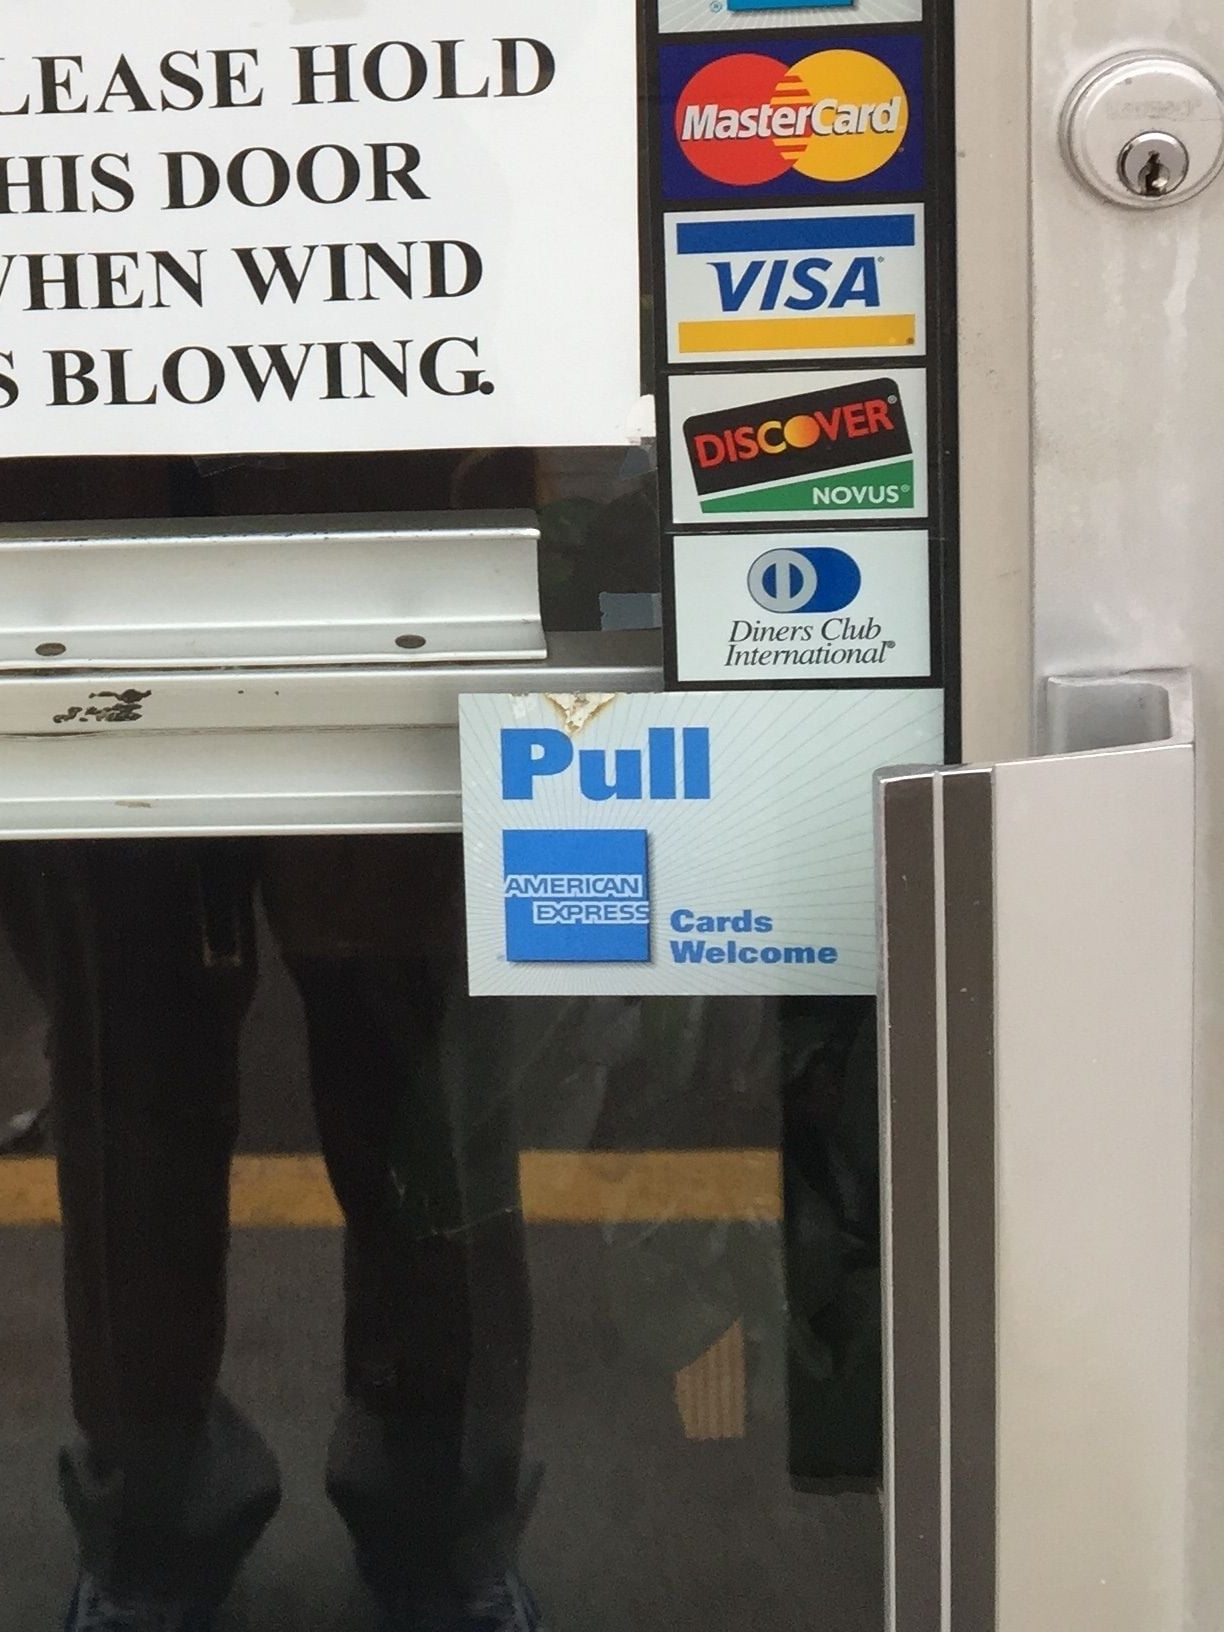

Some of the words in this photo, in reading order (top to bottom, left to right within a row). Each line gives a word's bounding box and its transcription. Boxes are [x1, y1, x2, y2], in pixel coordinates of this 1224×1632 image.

[290, 36, 556, 107] HOLD
[680, 94, 902, 142] MasterCard
[160, 141, 431, 212] DOOR
[231, 238, 484, 304] WIND
[706, 256, 881, 312] VISA
[46, 336, 495, 409] BLOWING.
[693, 398, 896, 469] DISCOVER
[812, 485, 900, 505] NOVUS
[724, 640, 889, 667] International
[728, 619, 814, 643] Diners
[820, 617, 882, 640] Club
[500, 727, 711, 801] Pull
[505, 874, 644, 899] AMERICAN
[532, 900, 649, 924] EXPRESS
[670, 908, 773, 934] Cards
[670, 939, 838, 964] Welcome
